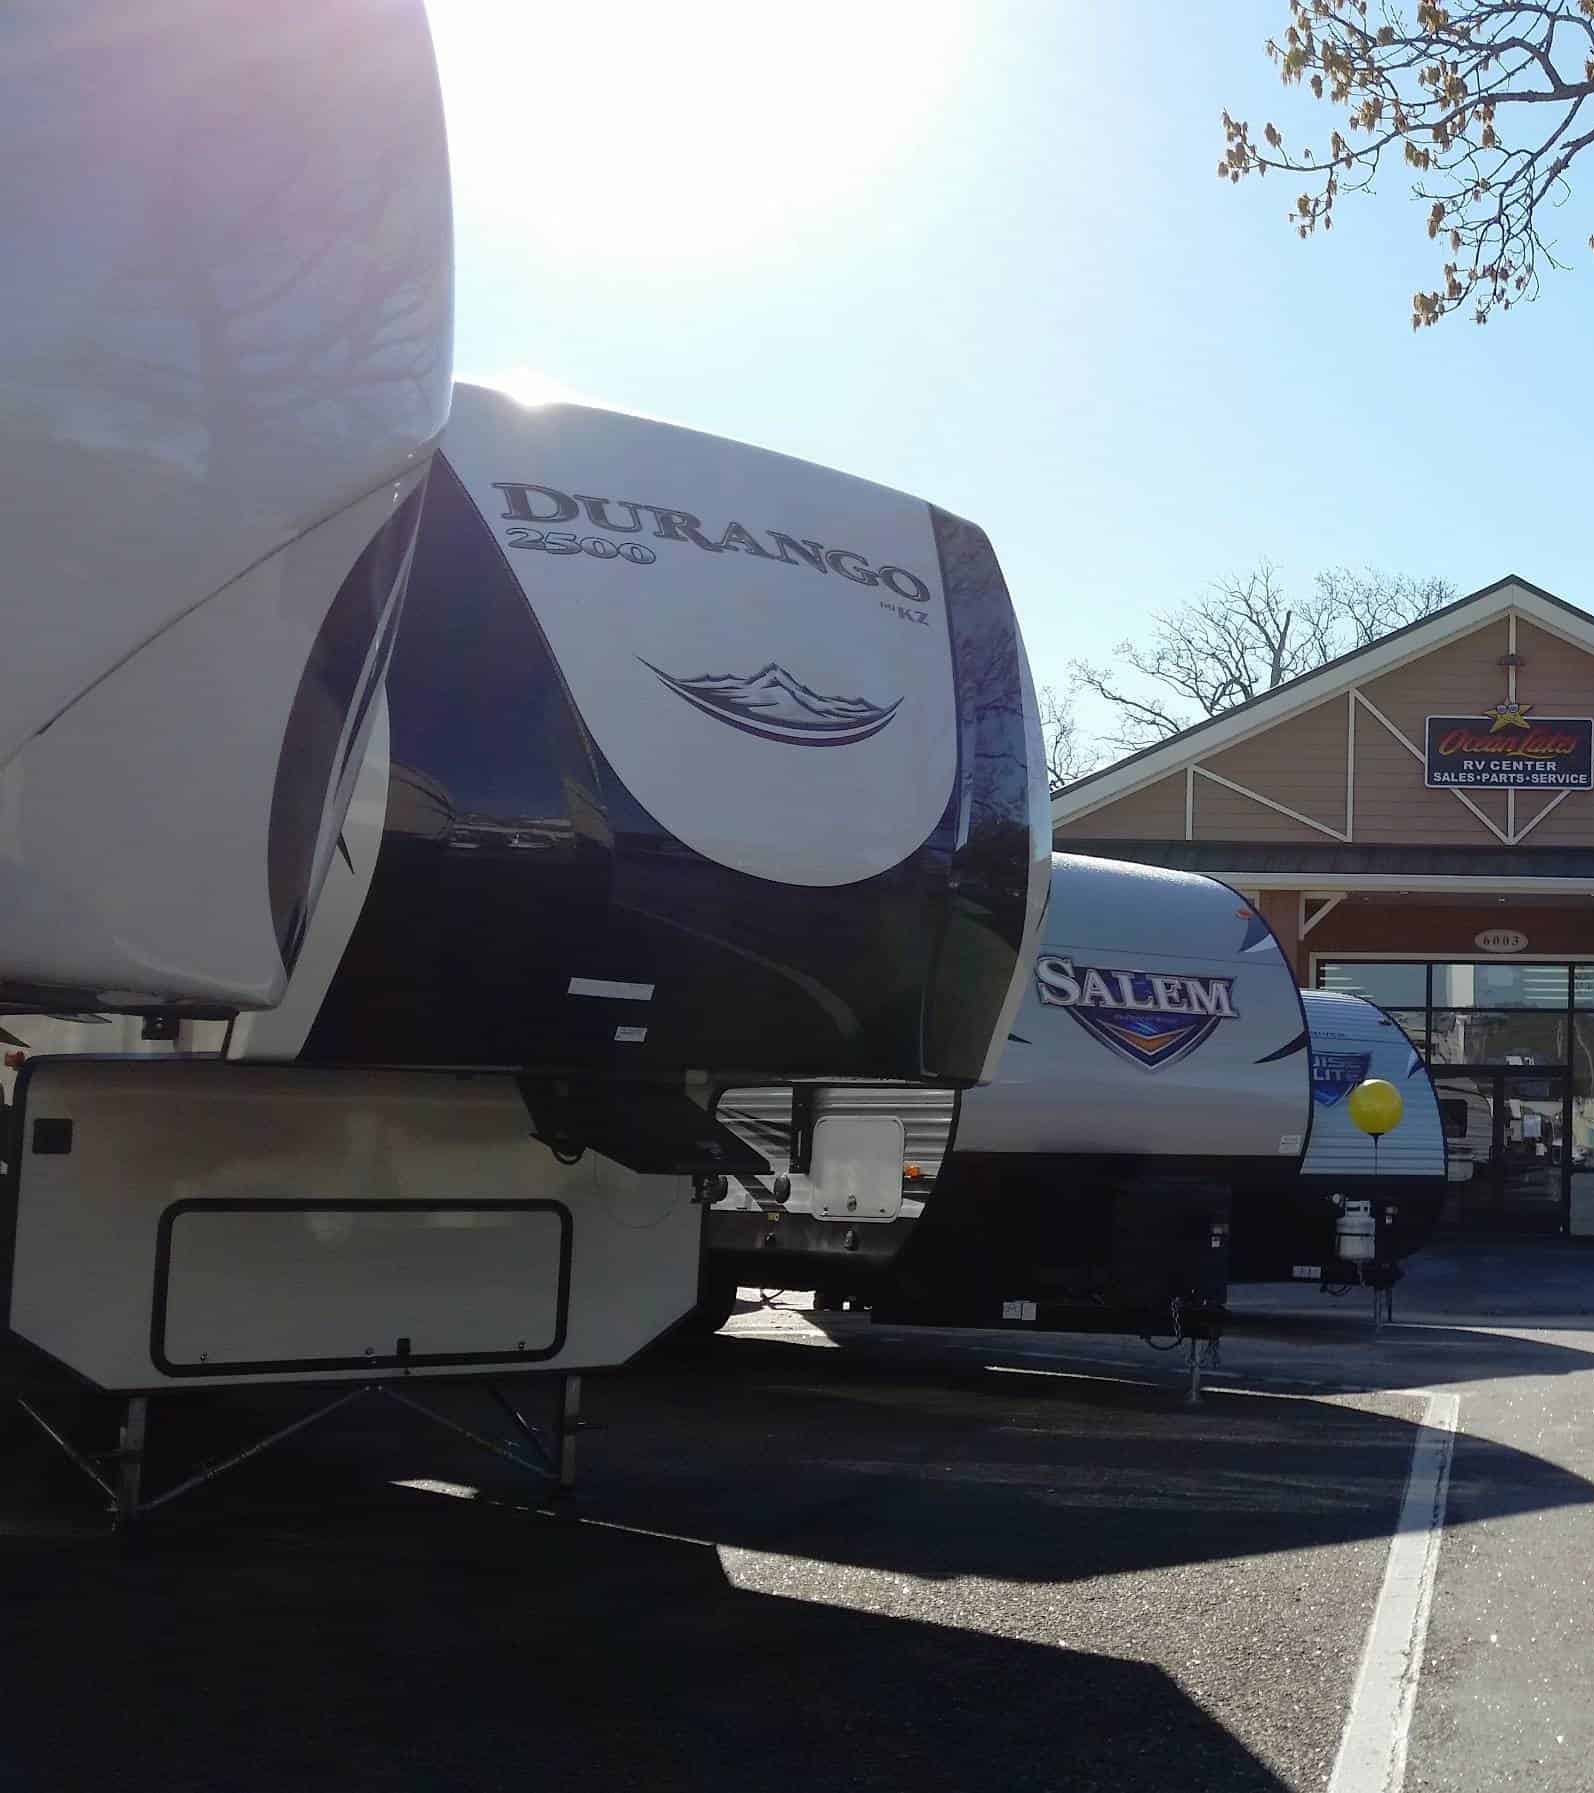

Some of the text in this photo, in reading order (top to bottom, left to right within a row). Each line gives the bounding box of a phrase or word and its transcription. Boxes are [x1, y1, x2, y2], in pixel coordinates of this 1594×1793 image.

[491, 481, 930, 603] DURANGO
[505, 527, 657, 565] 2500
[1433, 772, 1588, 784] SALES PARTS SERVICE
[1463, 760, 1557, 771] RV CENTER
[1036, 954, 1241, 1019] SALEM
